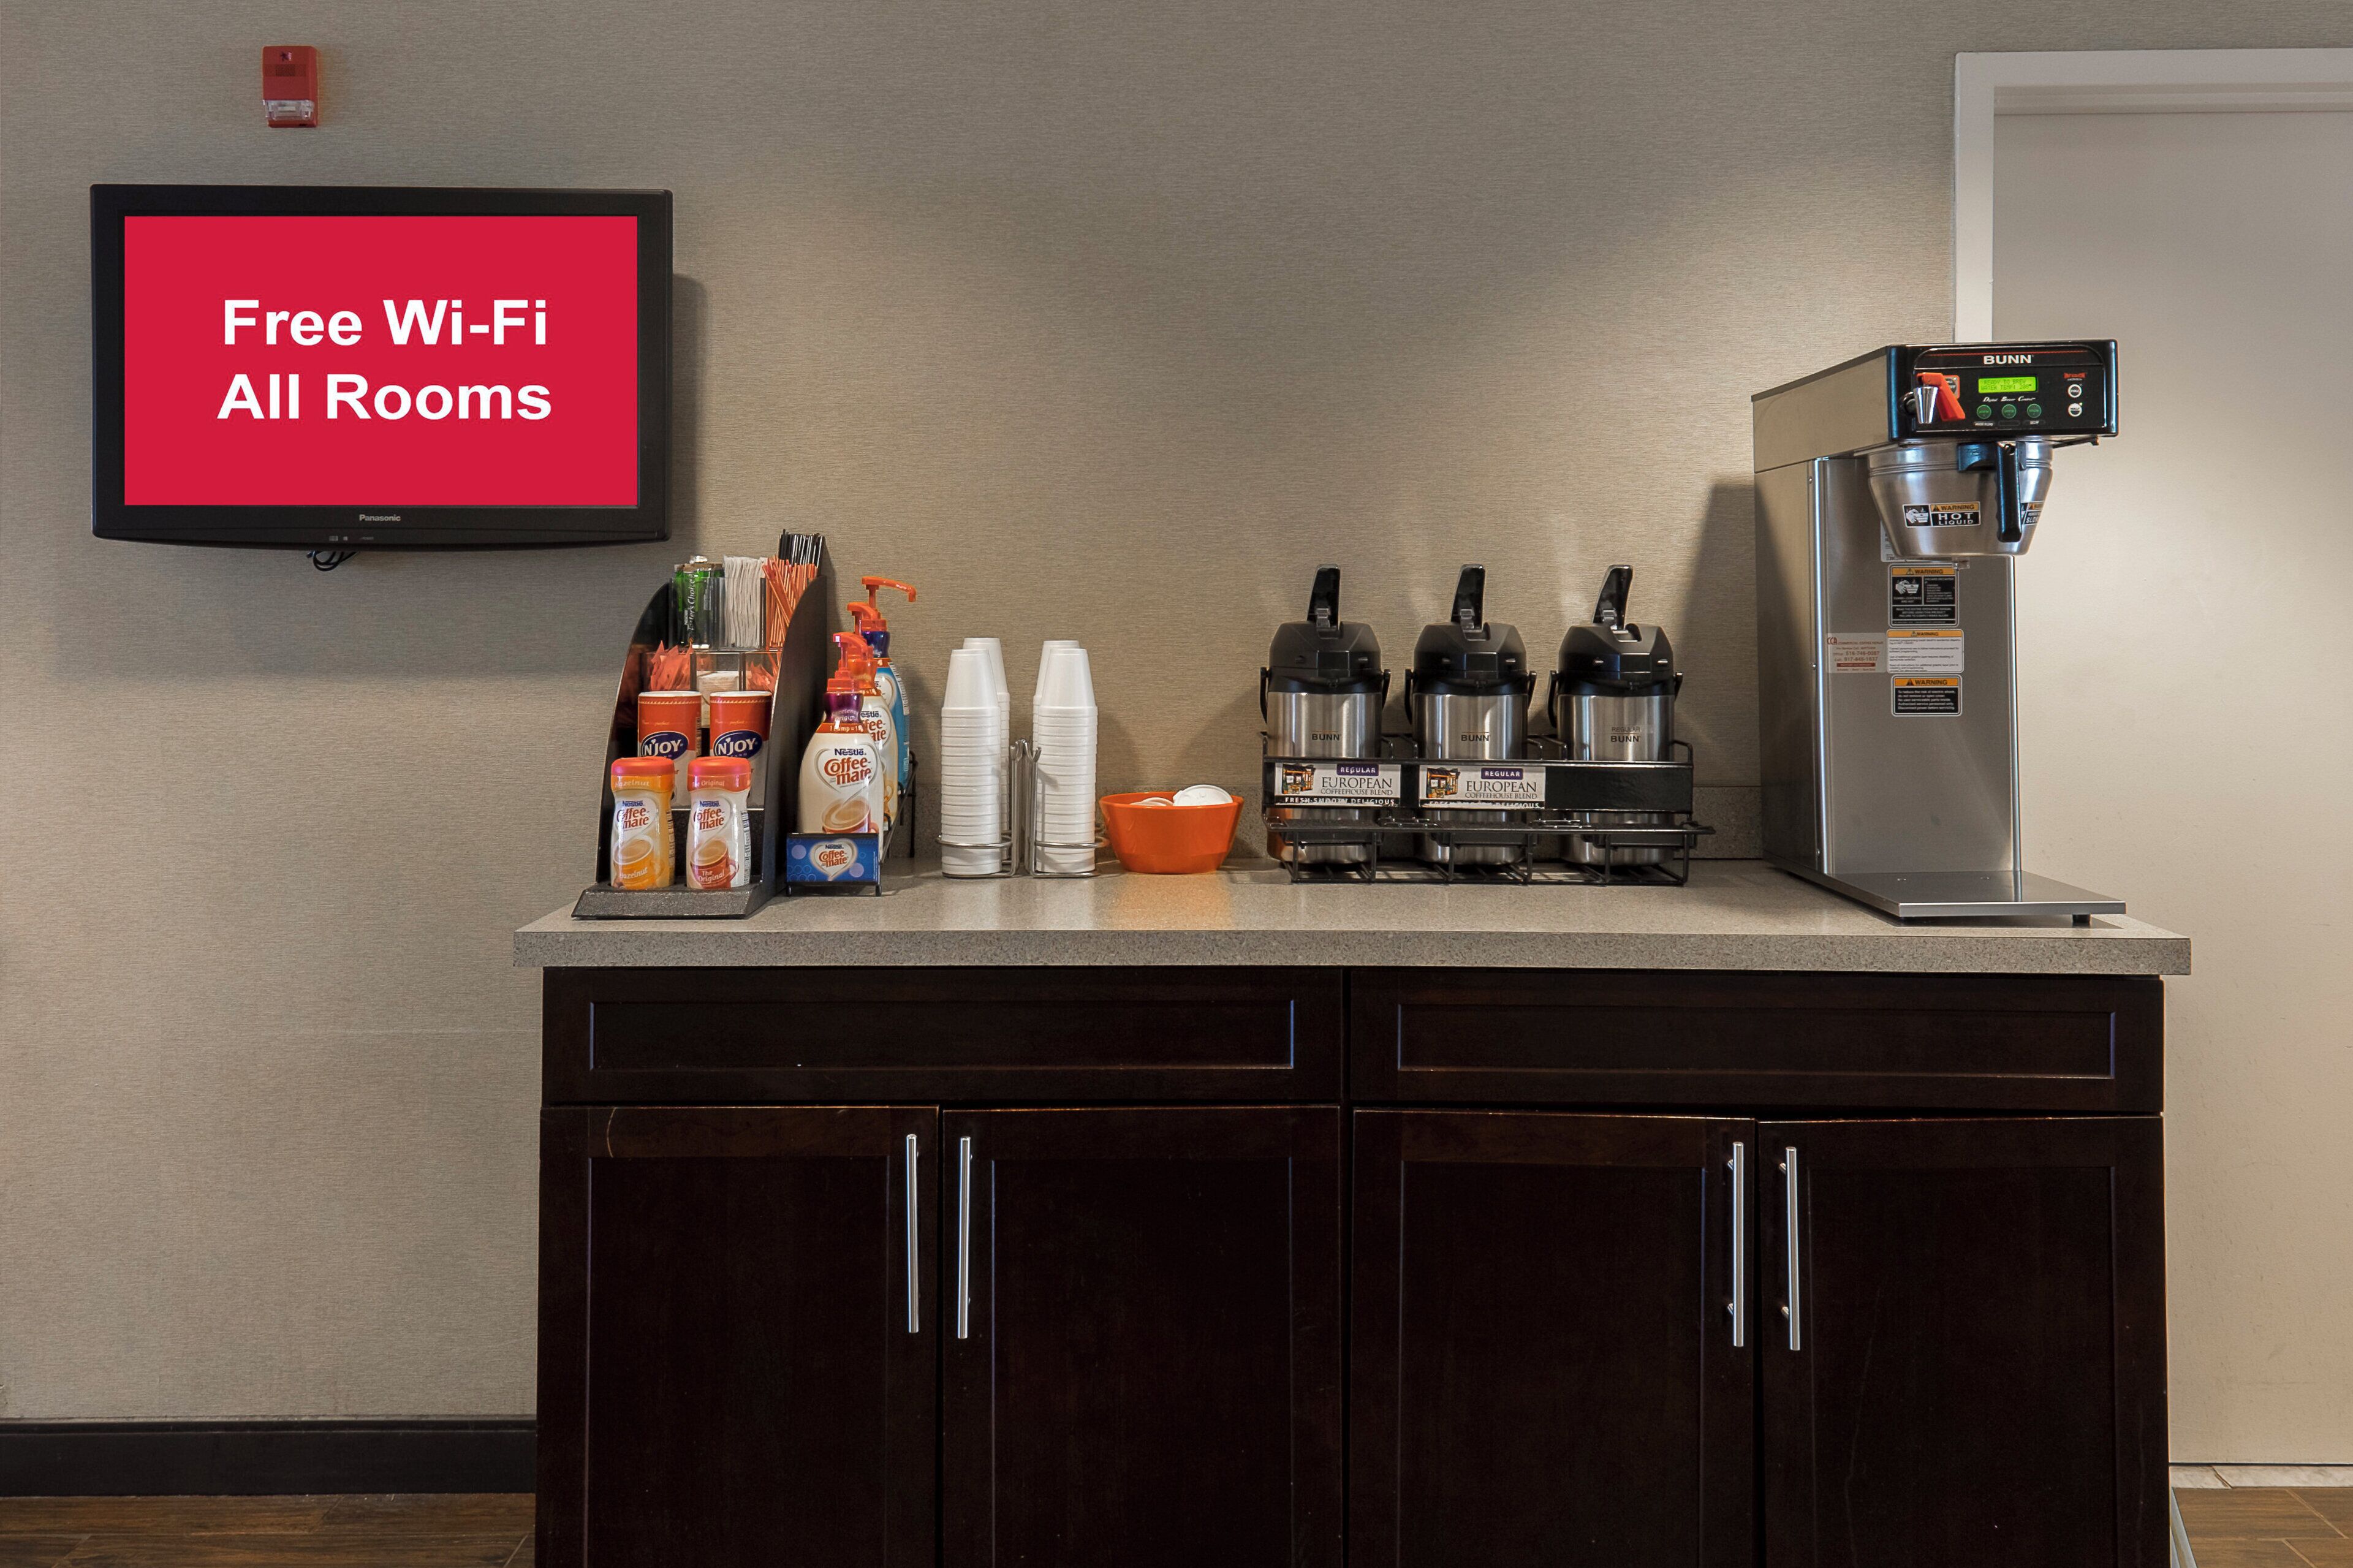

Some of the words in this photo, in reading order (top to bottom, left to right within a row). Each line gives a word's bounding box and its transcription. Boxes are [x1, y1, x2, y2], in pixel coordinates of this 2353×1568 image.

[224, 300, 362, 346] Free
[382, 300, 546, 345] Wi-Fi
[1984, 355, 2032, 365] BUNN
[216, 374, 300, 419] All
[327, 374, 552, 420] Rooms
[871, 729, 887, 741] ate
[836, 768, 872, 785] mate
[1322, 776, 1392, 789] EUROPEAN
[1466, 781, 1537, 792] EUROPEAN
[623, 816, 650, 829] mate
[699, 817, 725, 830] mate
[826, 857, 848, 868] mate
[698, 872, 725, 883] Original
